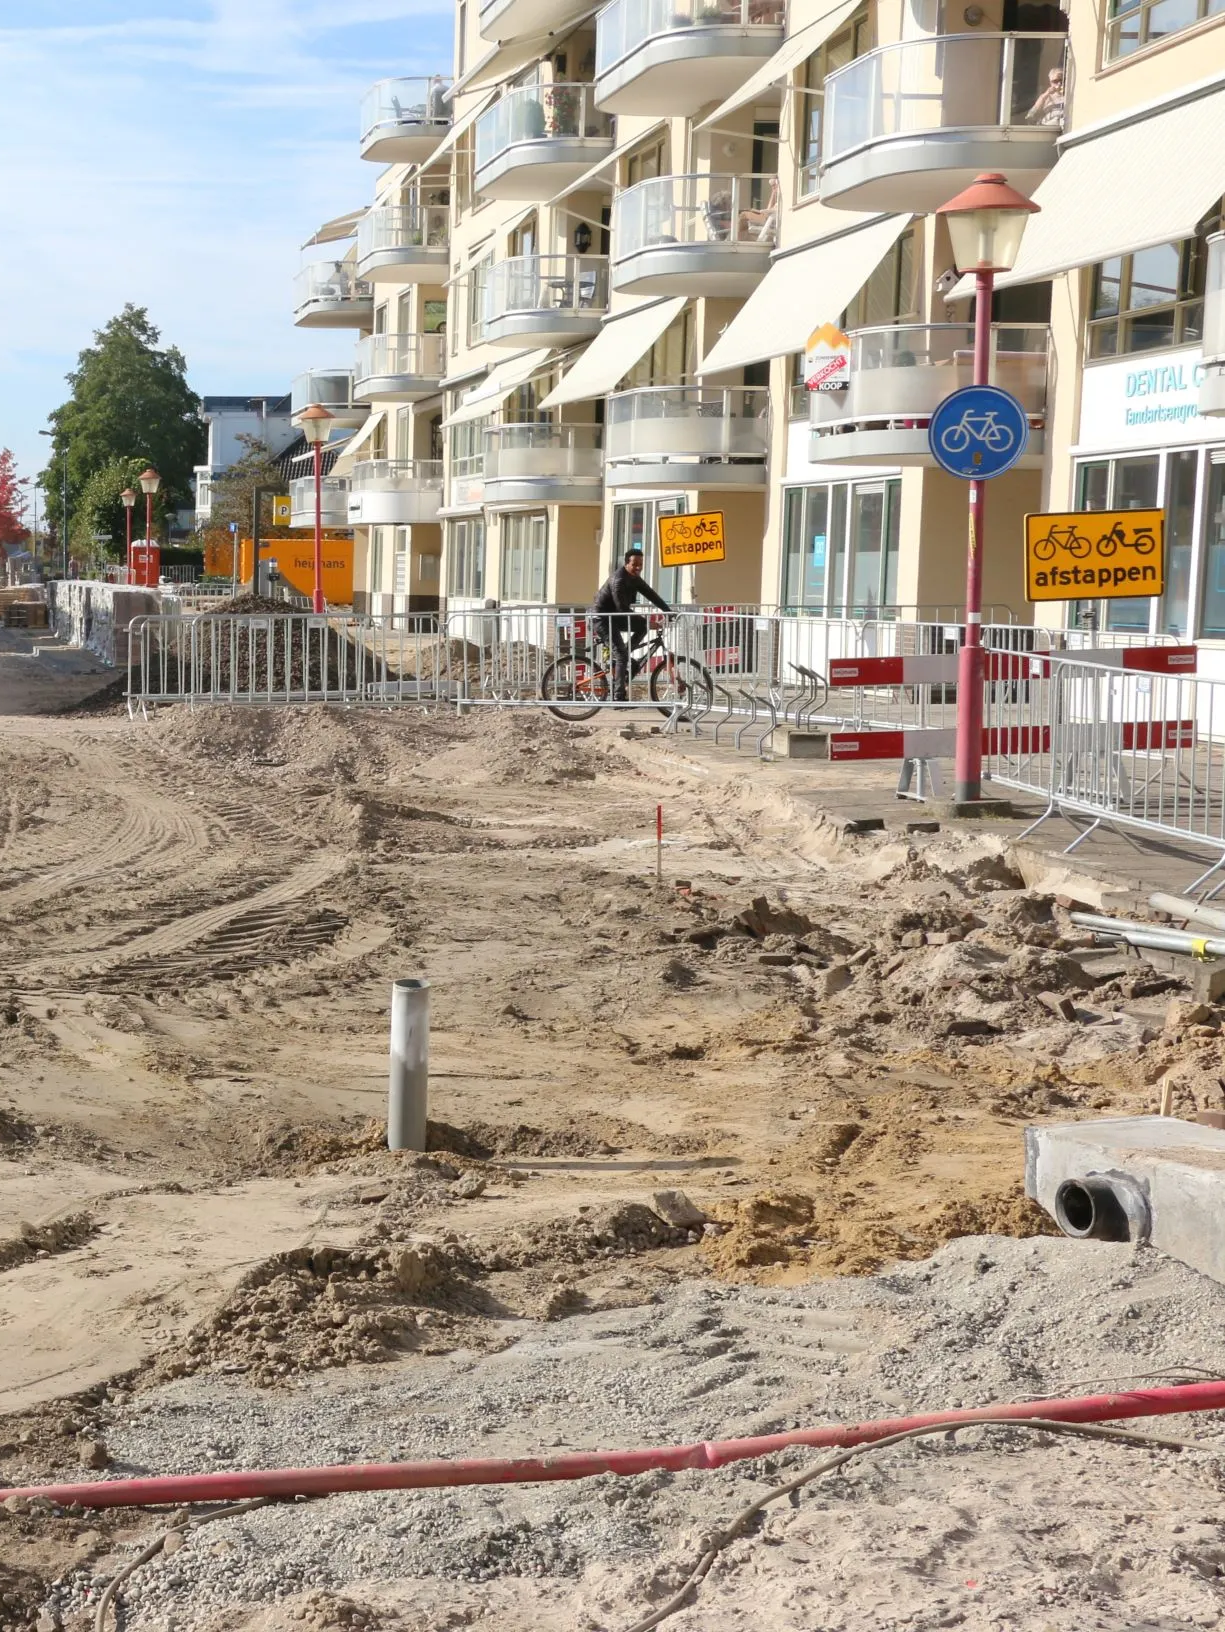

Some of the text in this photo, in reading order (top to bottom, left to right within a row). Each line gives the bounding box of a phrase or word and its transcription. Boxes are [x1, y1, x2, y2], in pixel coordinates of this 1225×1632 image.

[1126, 364, 1188, 398] DENTAL
[1126, 403, 1198, 425] Tandartsengro
[664, 540, 723, 555] afstappen
[1035, 565, 1156, 588] afstappen
